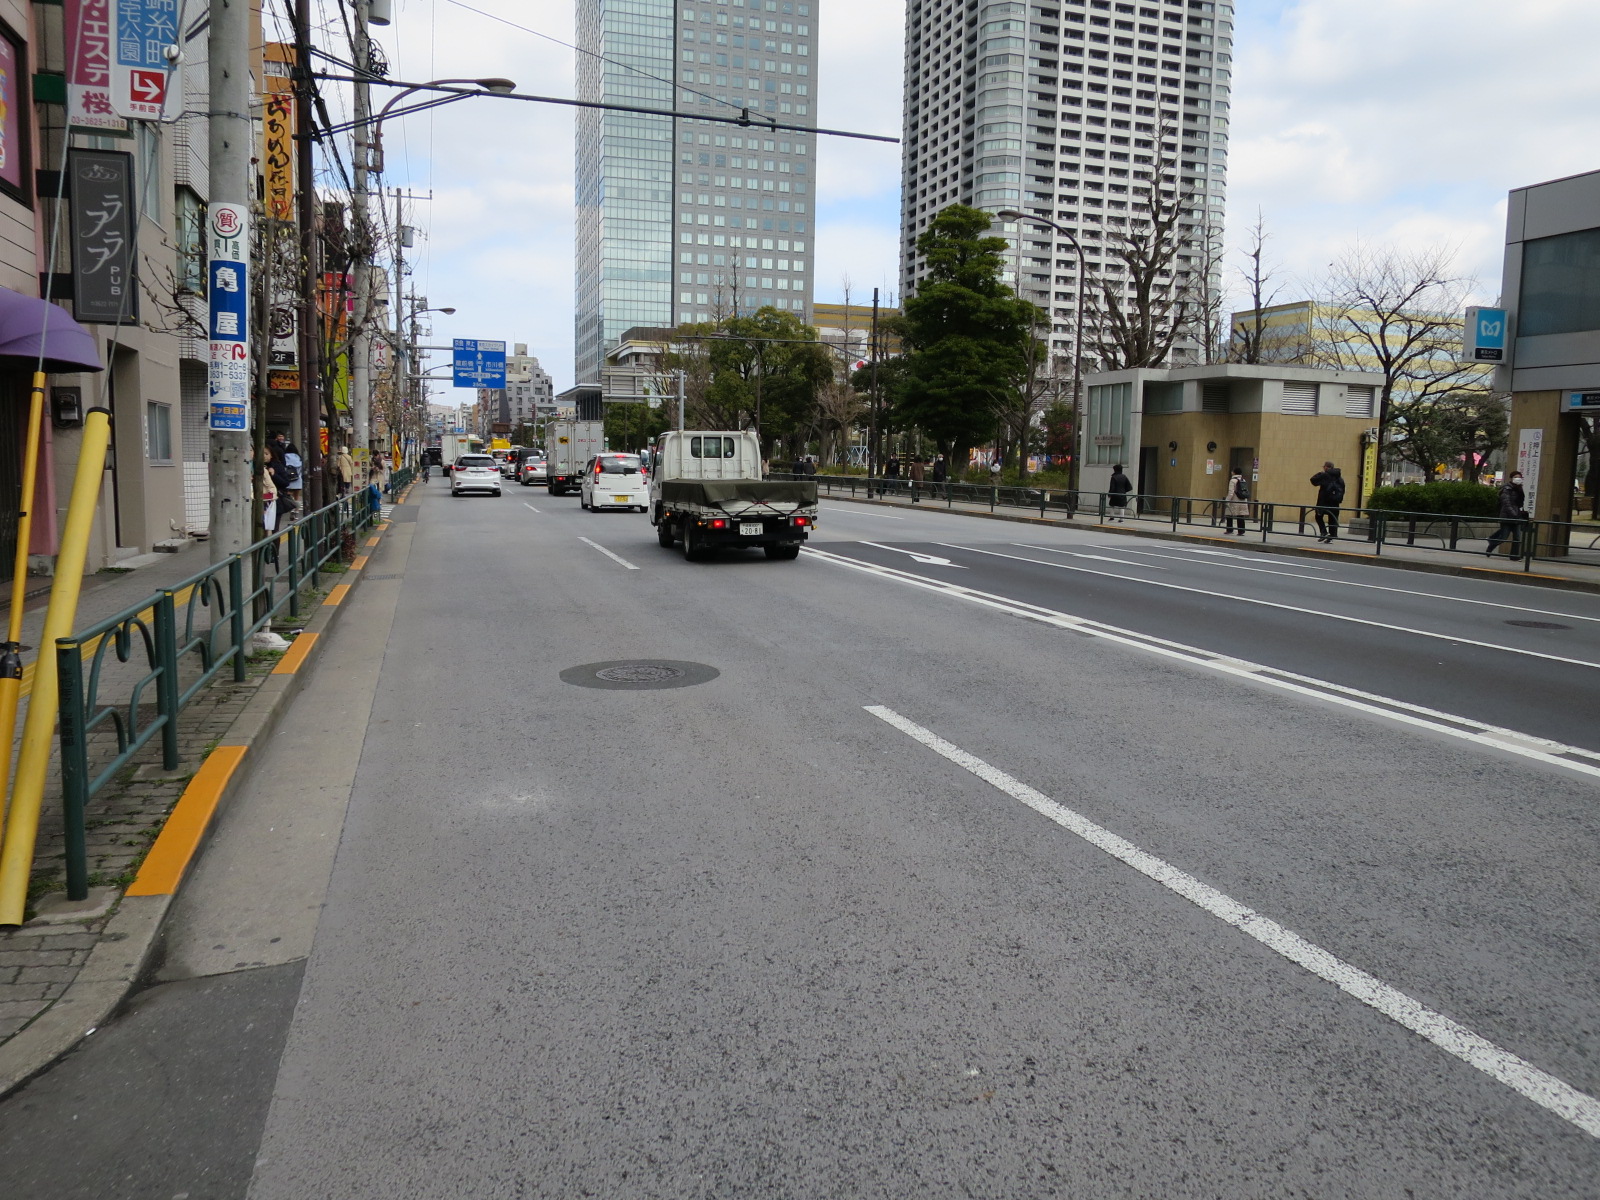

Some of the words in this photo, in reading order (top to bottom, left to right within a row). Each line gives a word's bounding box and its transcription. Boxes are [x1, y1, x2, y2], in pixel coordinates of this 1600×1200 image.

[81, 90, 113, 116] 桜
[71, 116, 126, 129] 03-3625-1318
[110, 265, 122, 296] PUB
[215, 266, 239, 335] 亀屋
[274, 352, 287, 363] 2F
